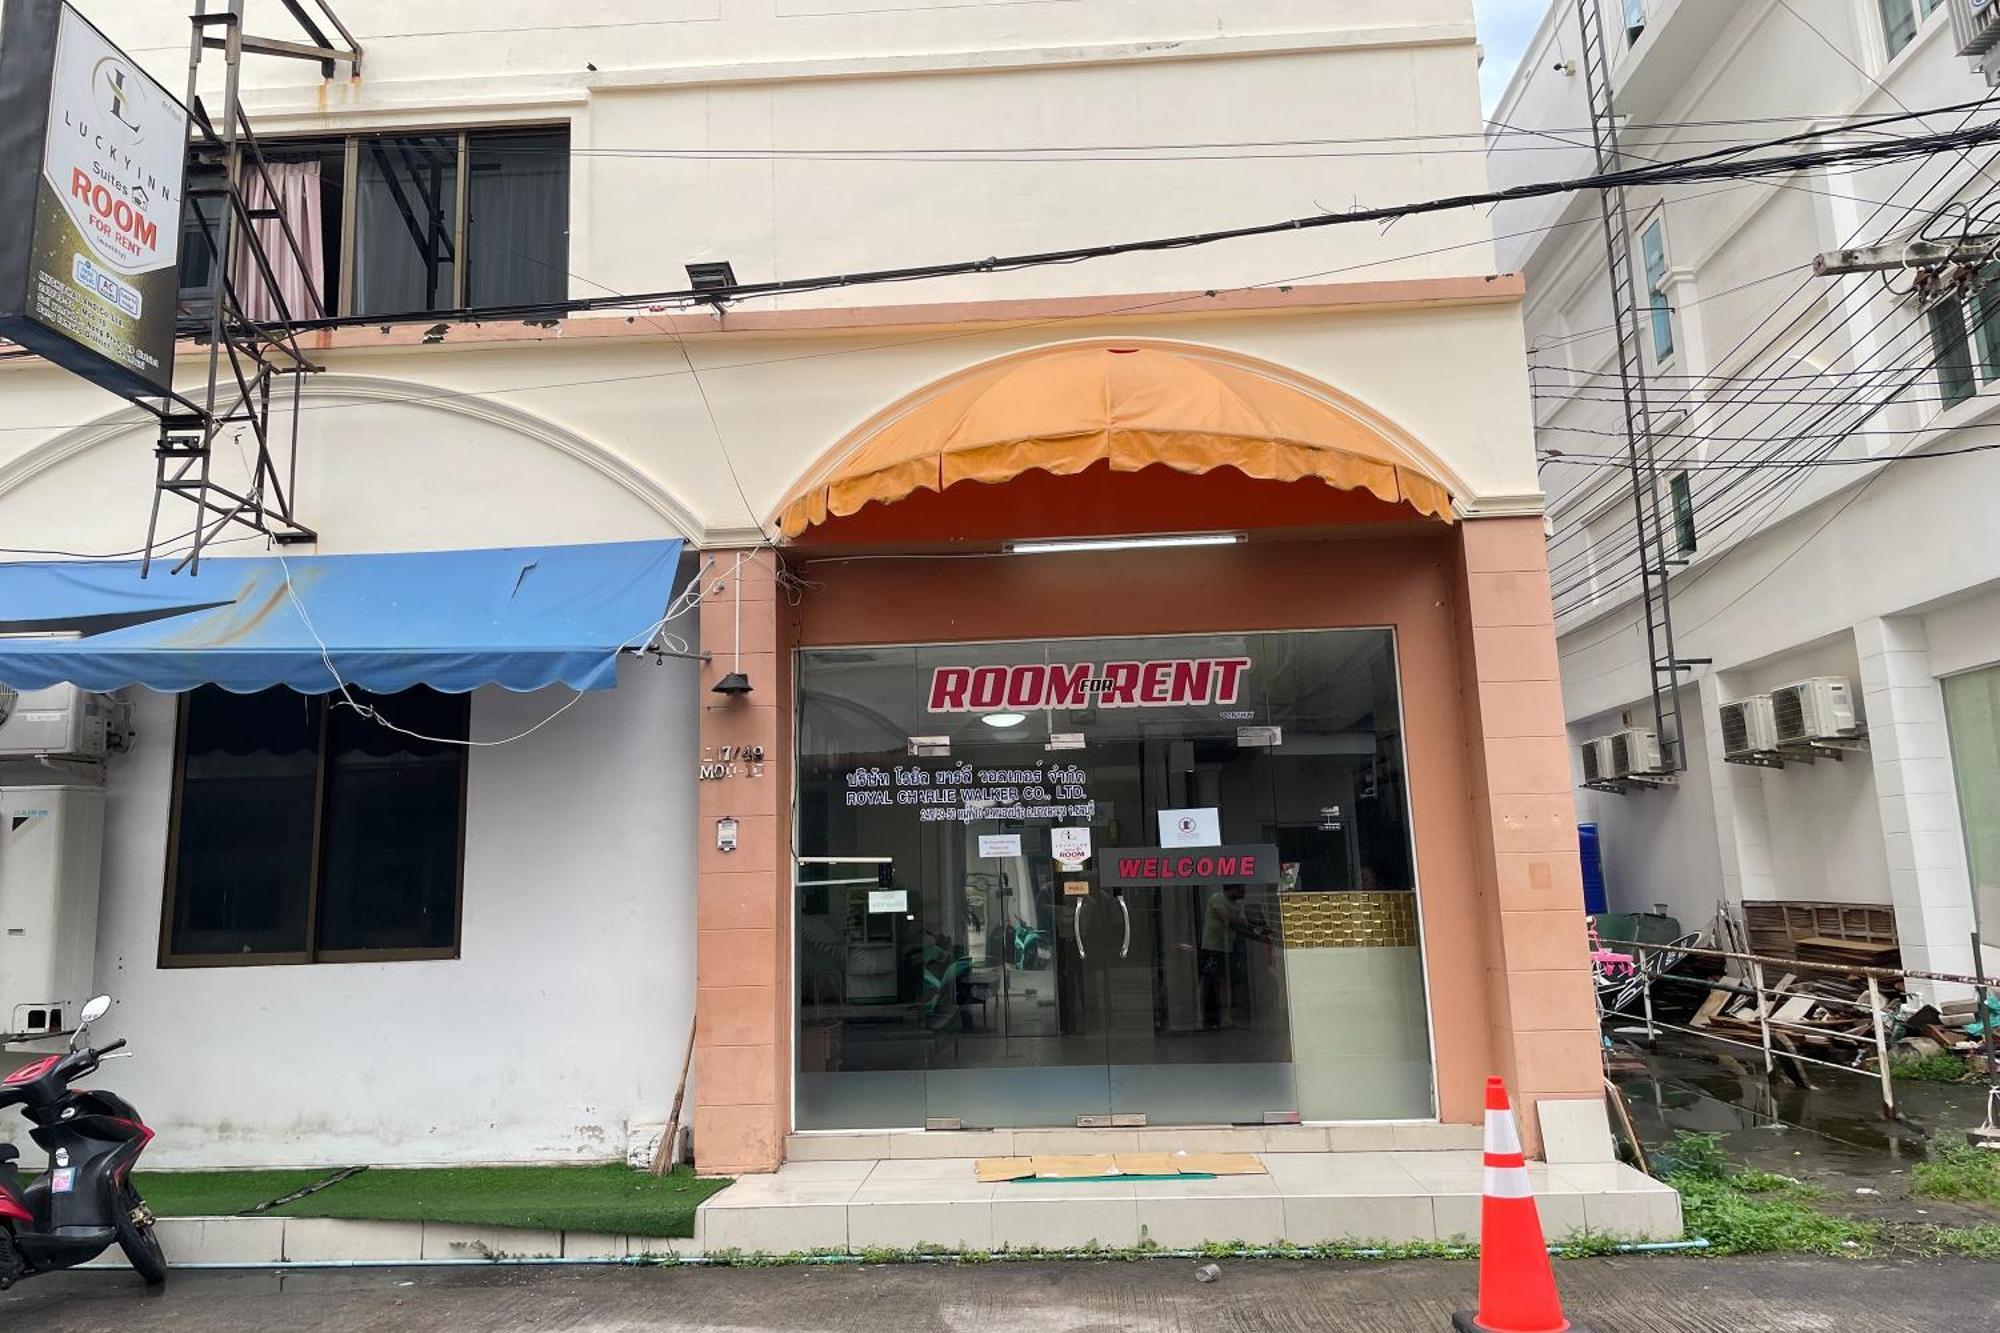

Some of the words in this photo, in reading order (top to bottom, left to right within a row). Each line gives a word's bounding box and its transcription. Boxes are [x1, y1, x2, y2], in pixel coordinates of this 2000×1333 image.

[92, 160, 128, 196] Suites
[71, 166, 157, 252] ROOM
[88, 213, 112, 238] FOR
[114, 231, 141, 257] RENT
[928, 662, 1094, 712] ROOM
[1079, 679, 1114, 693] FOR
[1097, 657, 1251, 708] RENT
[846, 767, 890, 787] บริษัท
[1047, 763, 1086, 785] จำกัด
[846, 790, 893, 805] ROYAL
[896, 788, 956, 804] CHARLIE
[960, 785, 1020, 801] WALKER
[1055, 784, 1088, 799] LTD.
[1118, 854, 1256, 880] WELCOME
